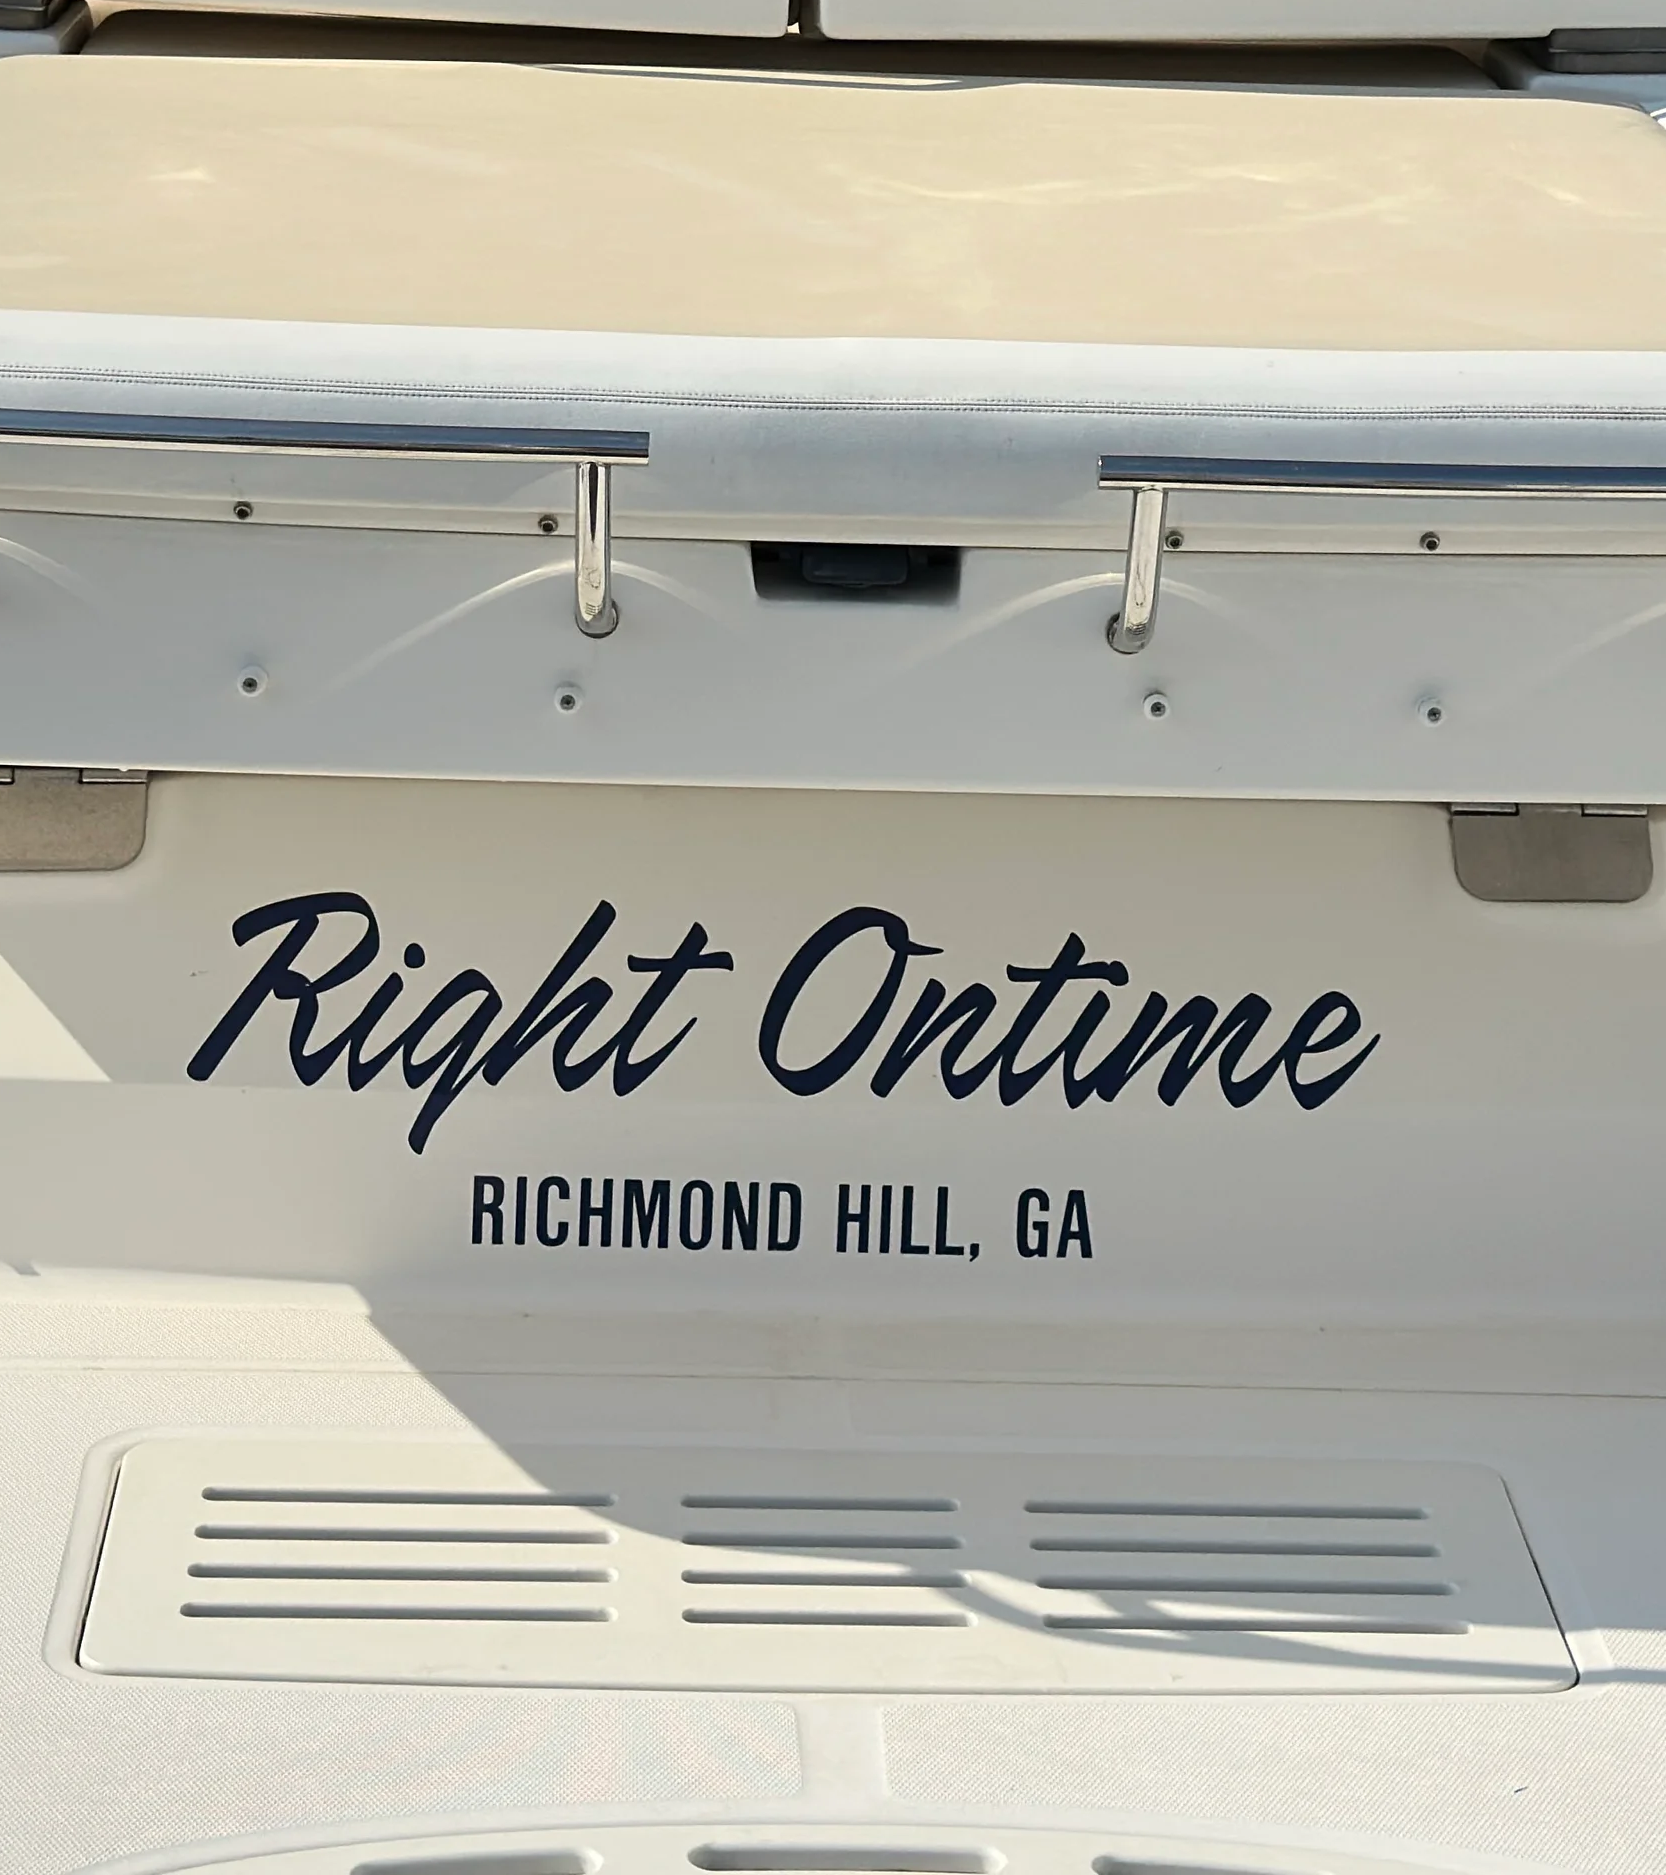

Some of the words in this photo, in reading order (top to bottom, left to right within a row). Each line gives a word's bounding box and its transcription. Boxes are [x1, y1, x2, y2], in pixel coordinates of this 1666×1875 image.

[186, 891, 734, 1155] Right
[758, 906, 1381, 1111] Ontime
[471, 1175, 802, 1252] RICHMOND
[836, 1183, 980, 1263] HILL,
[1016, 1187, 1093, 1259] GA
